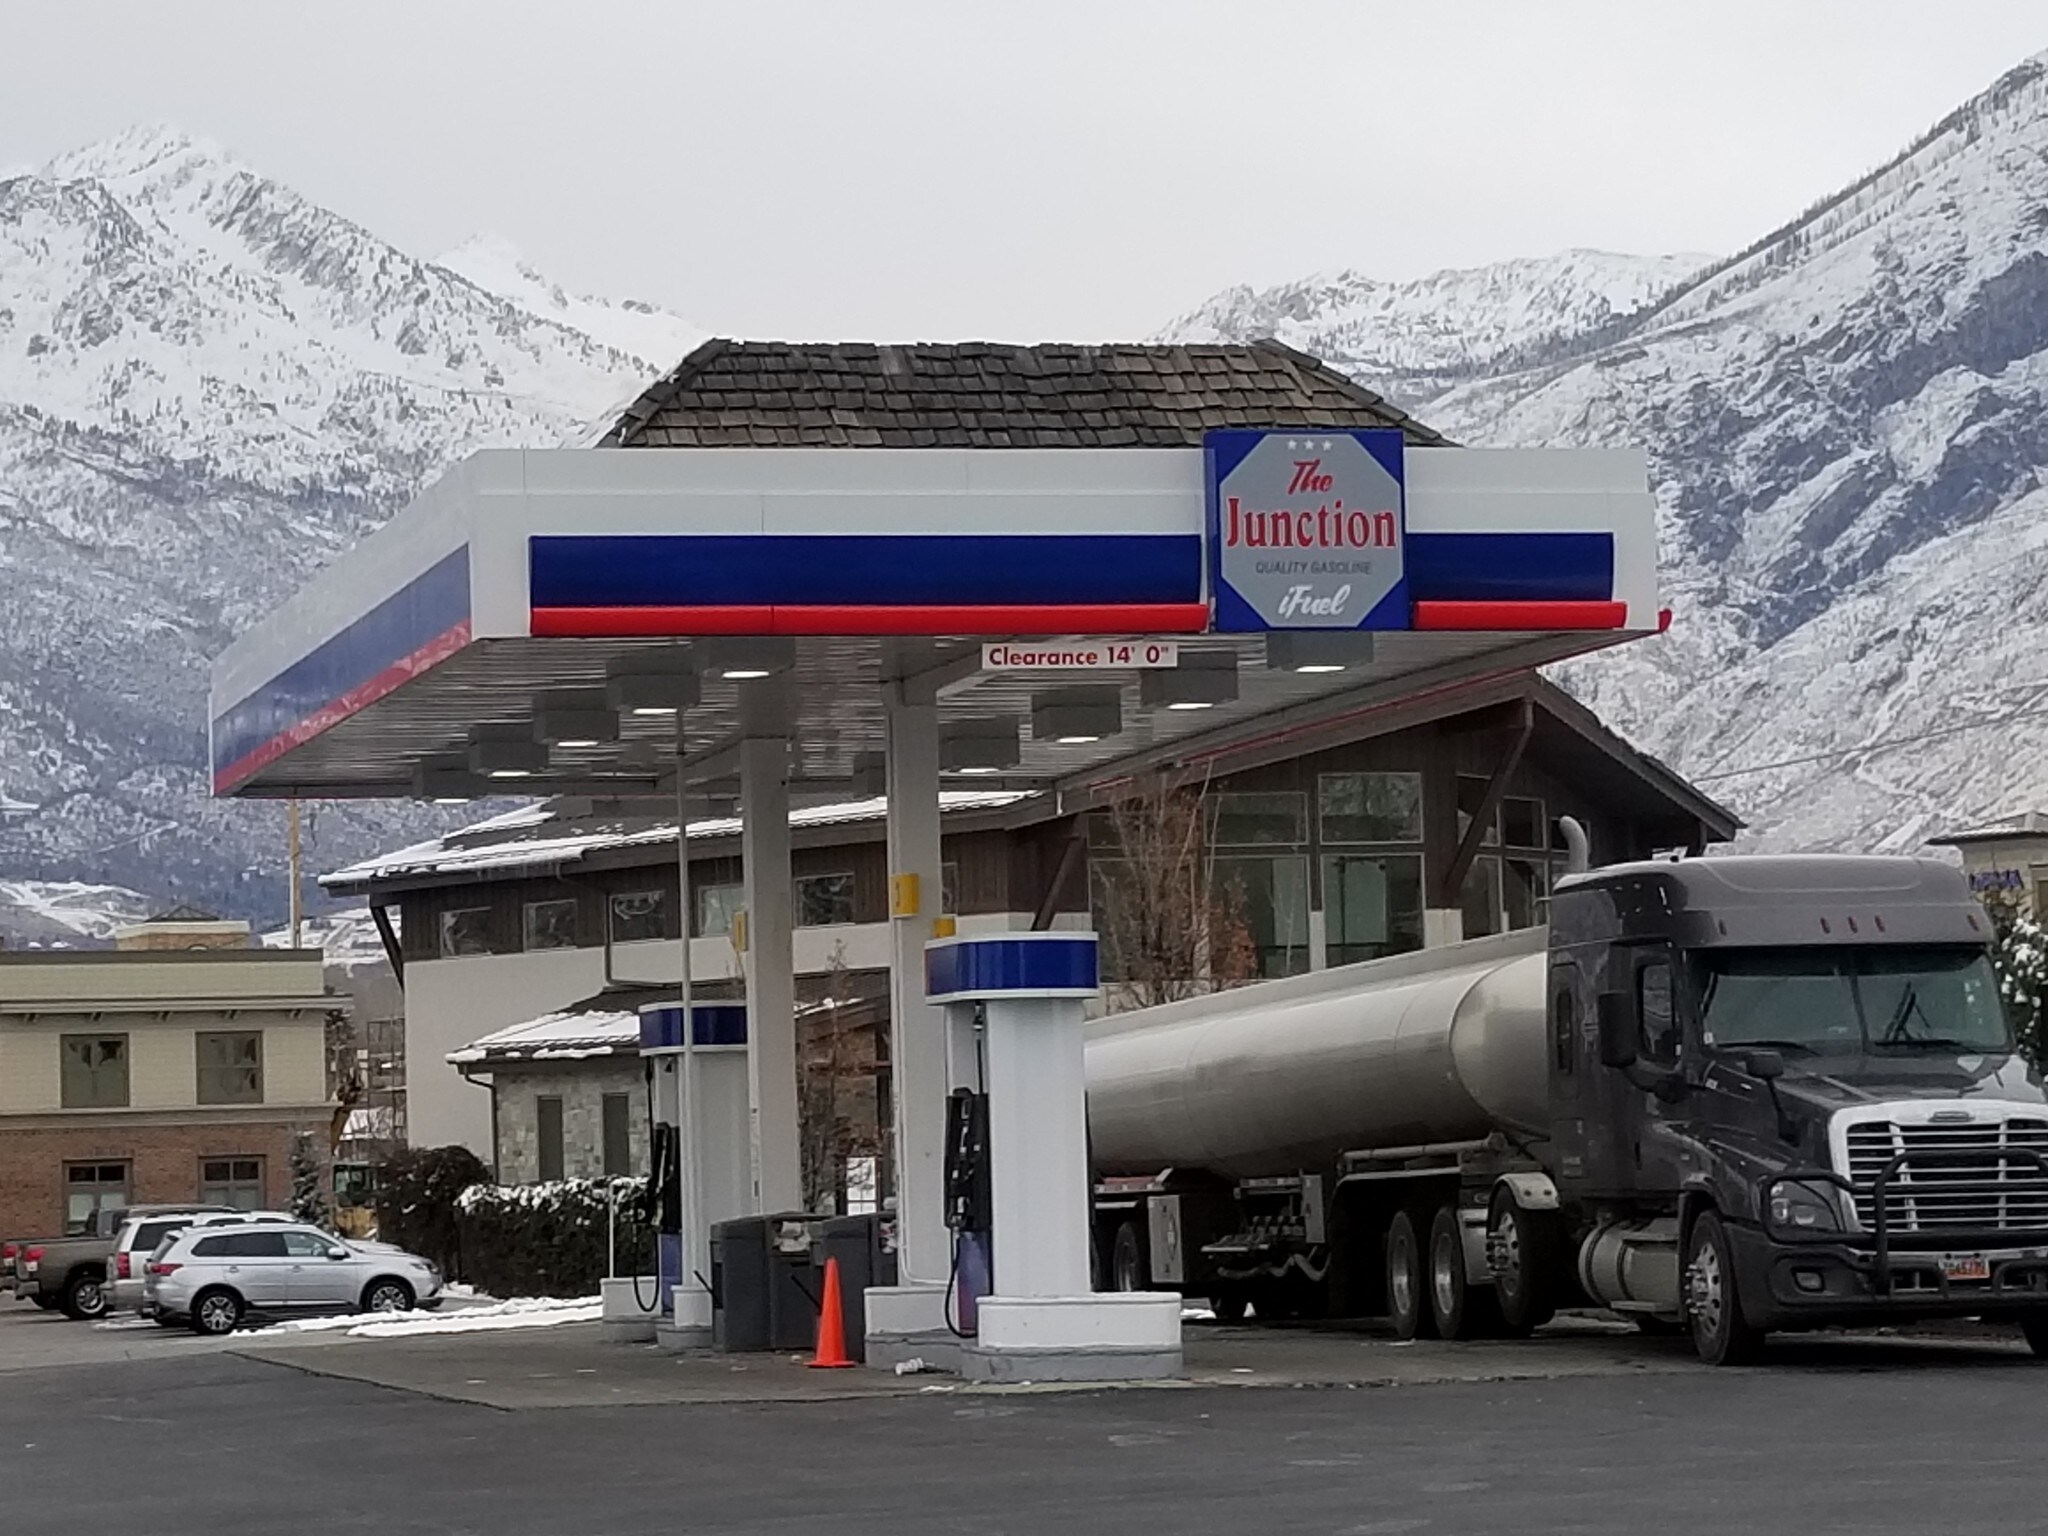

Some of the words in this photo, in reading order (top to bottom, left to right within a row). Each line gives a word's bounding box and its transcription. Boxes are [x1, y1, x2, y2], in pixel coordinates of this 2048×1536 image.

[1287, 458, 1333, 495] The
[1226, 498, 1397, 548] Junction
[1255, 561, 1307, 574] QUALITY
[1310, 561, 1371, 575] GASOLINE
[1278, 584, 1351, 619] iFuel
[988, 646, 1098, 666] Clearance
[1106, 646, 1135, 664] 14'
